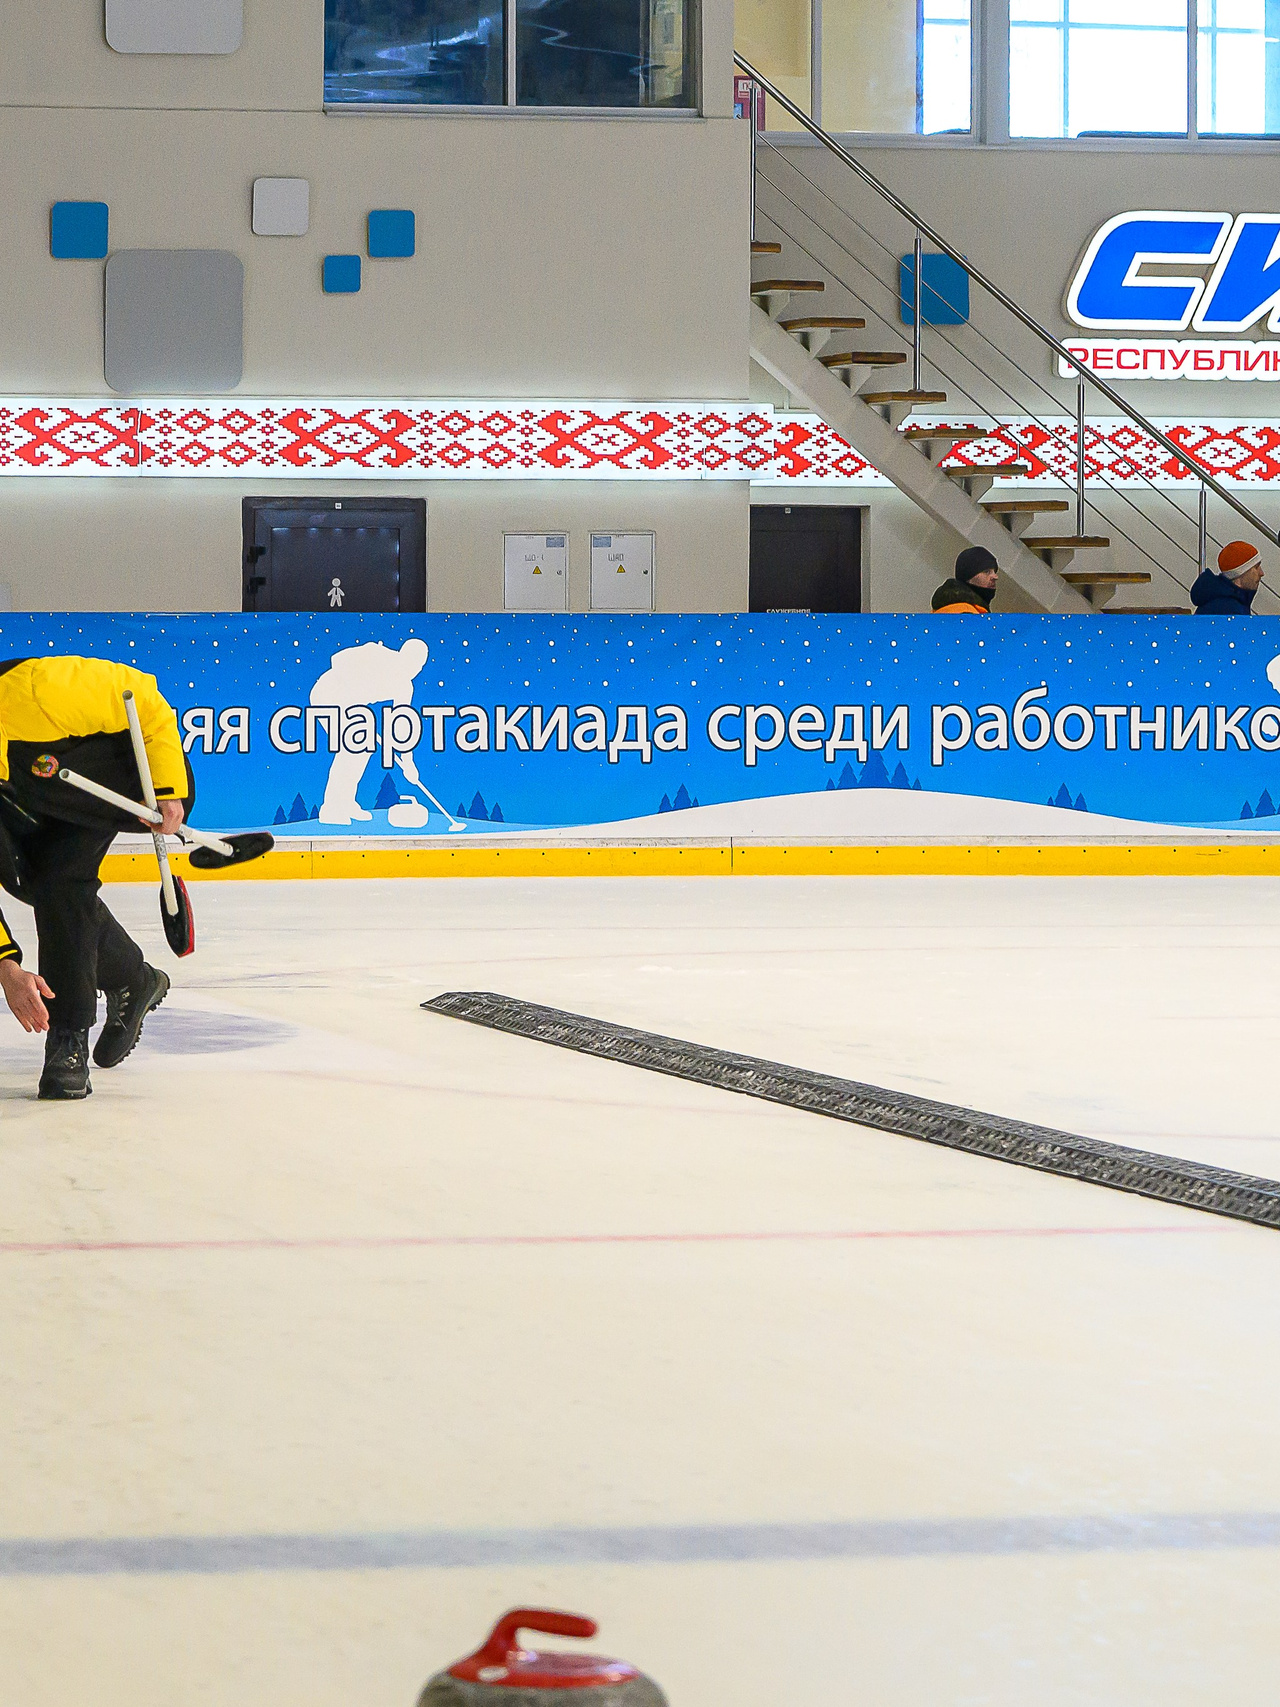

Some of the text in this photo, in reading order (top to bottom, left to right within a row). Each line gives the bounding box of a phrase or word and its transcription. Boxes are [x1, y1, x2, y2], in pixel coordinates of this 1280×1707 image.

[269, 704, 688, 768] спартакиада
[707, 703, 910, 766] среди
[931, 686, 1280, 767] работнико
